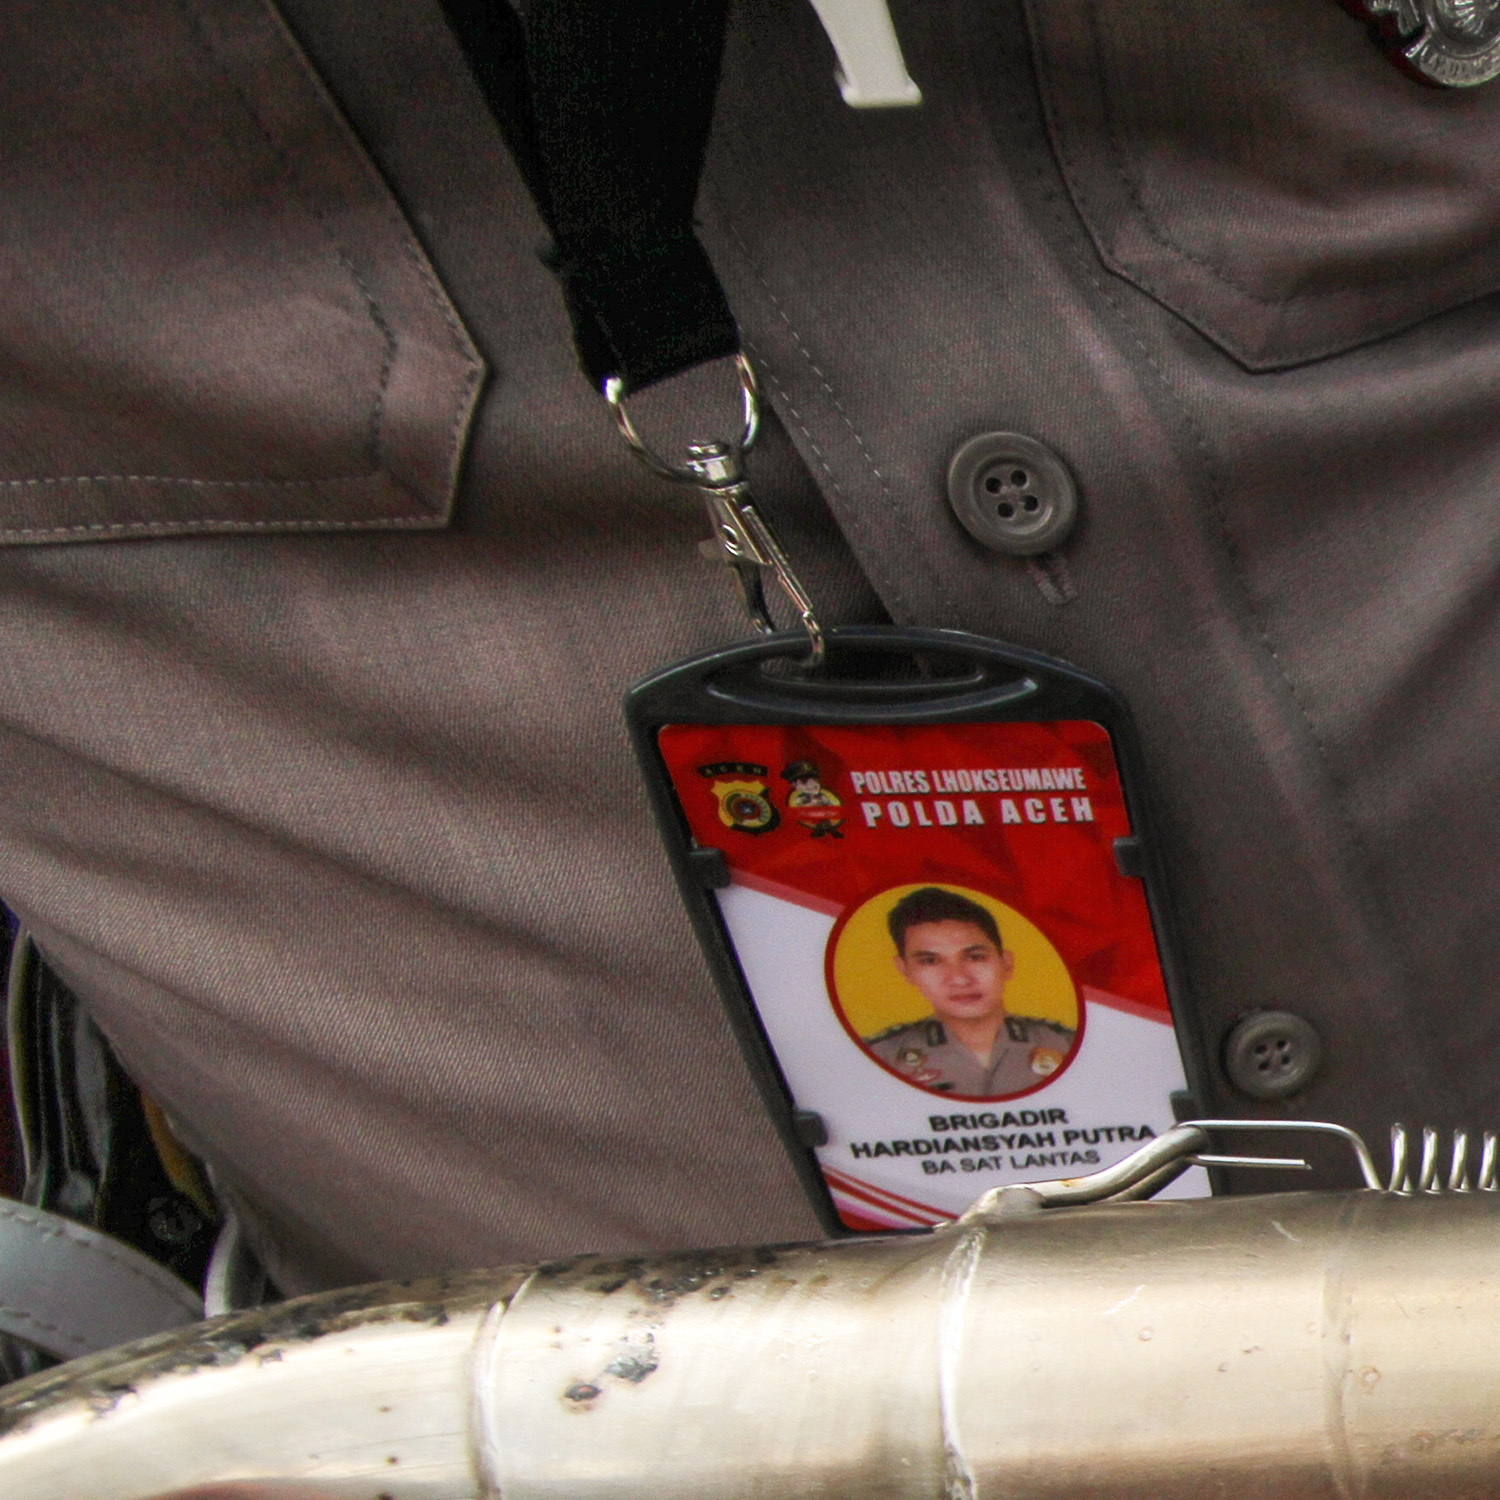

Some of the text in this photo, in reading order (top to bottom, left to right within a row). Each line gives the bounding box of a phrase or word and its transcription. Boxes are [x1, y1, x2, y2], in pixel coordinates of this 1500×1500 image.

[850, 767, 1087, 795] POLRES LHOKSEUMAWE
[860, 797, 1094, 828] POLDA ACEH
[928, 1107, 1069, 1133] BRIGADIR
[850, 1124, 1157, 1159] HARDIANSYAH PUTRA
[921, 1149, 1101, 1175] BA SAT LANTAS
